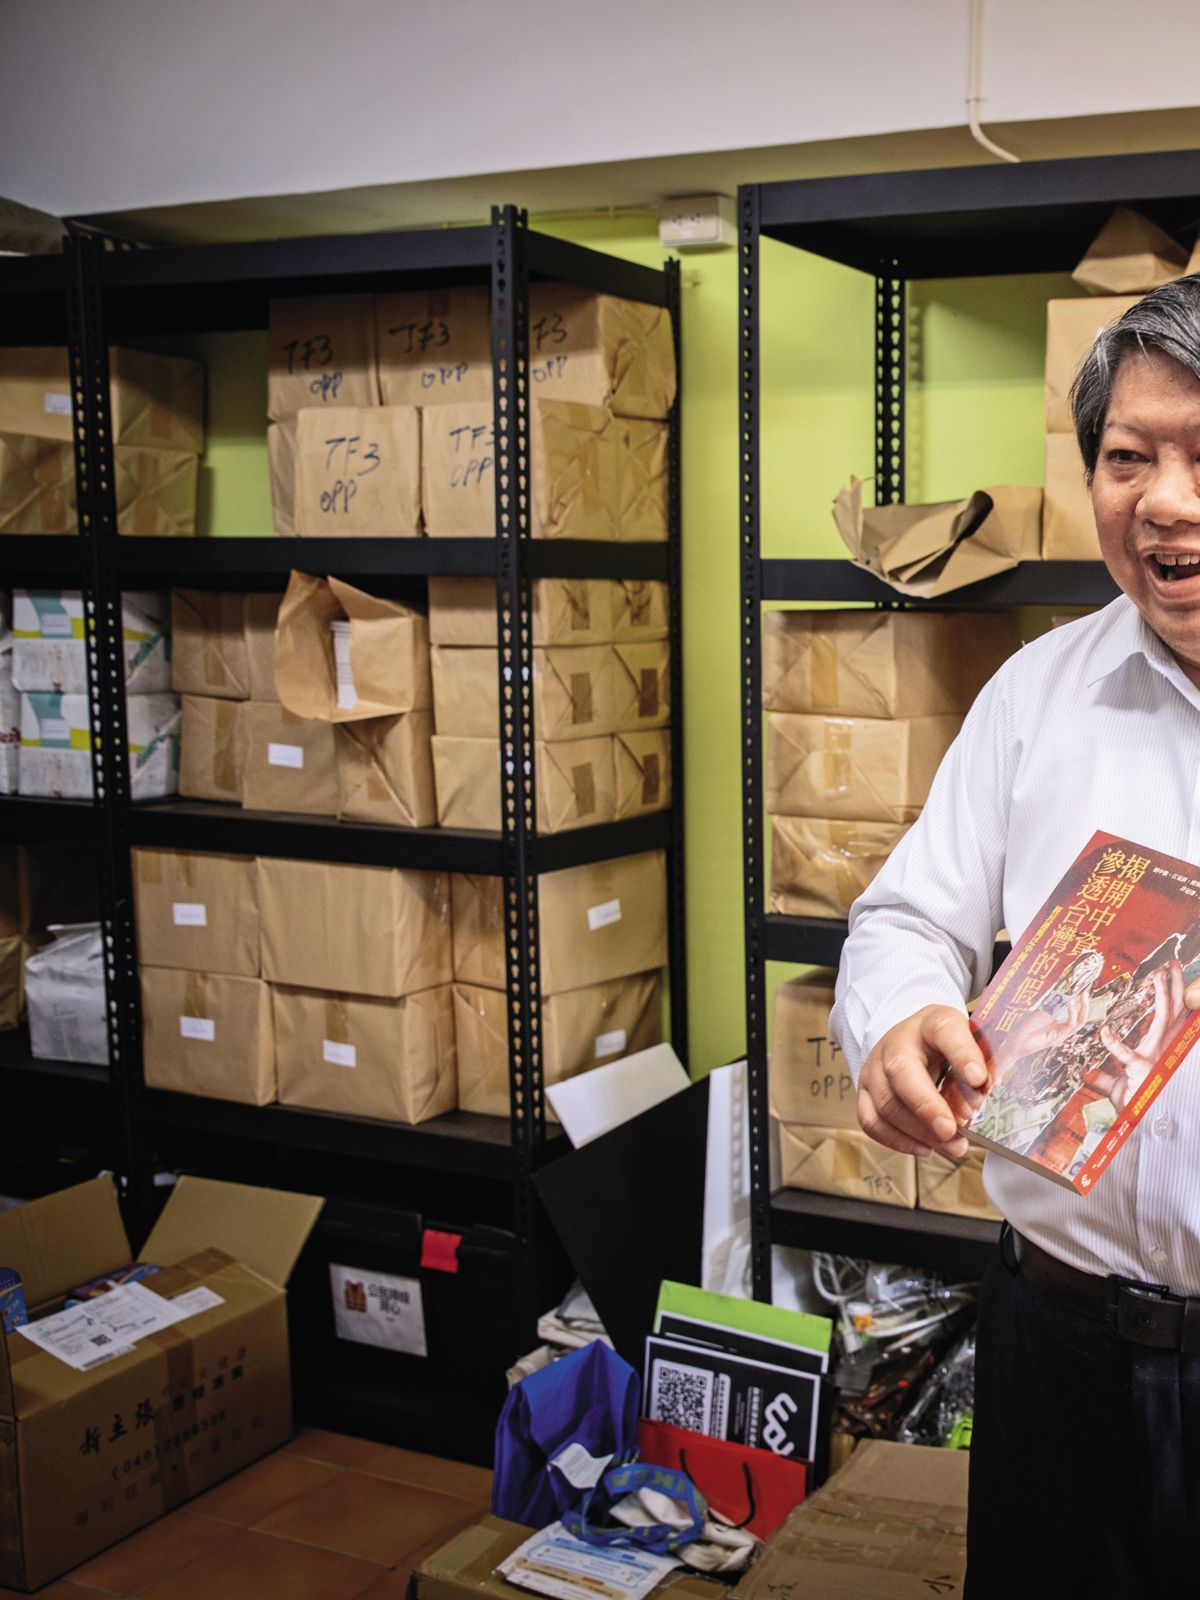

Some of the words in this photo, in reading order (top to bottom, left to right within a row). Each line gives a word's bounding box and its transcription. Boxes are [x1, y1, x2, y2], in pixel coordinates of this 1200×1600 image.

[533, 314, 568, 350] F3
[325, 437, 382, 477] TF3
[1065, 854, 1151, 957] 揭開中資
[994, 847, 1127, 1032] 滲透台灣的假面
[807, 1036, 843, 1067] TF
